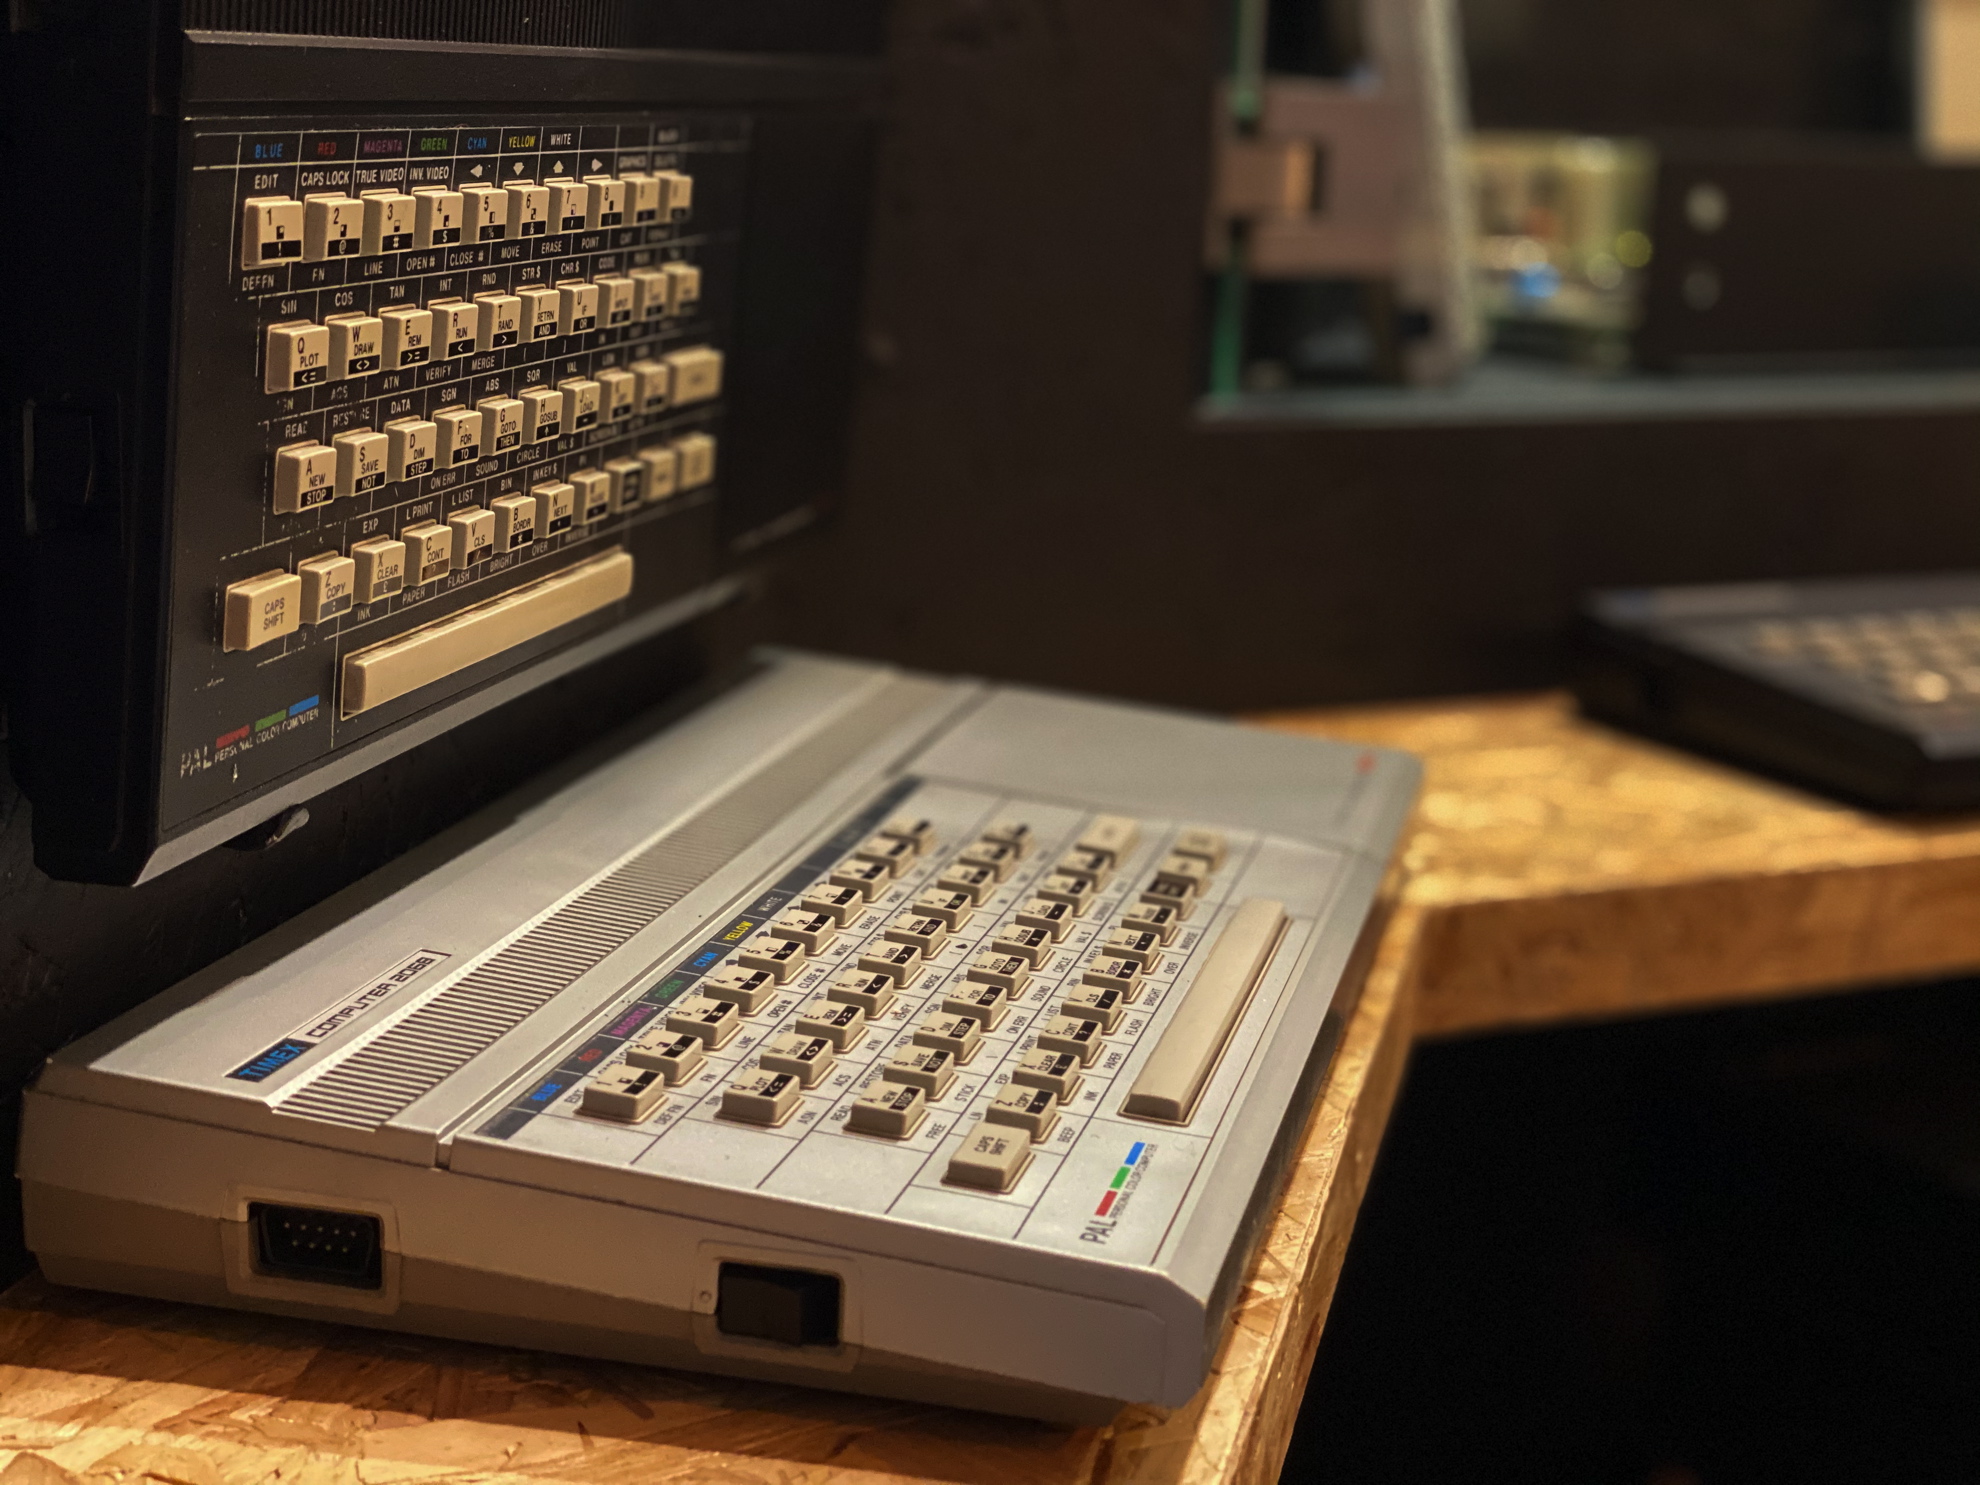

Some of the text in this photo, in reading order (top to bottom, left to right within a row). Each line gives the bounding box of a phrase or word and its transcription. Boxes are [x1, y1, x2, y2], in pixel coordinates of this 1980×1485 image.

[363, 138, 403, 154] MAGENTA
[420, 137, 448, 151] GREEN
[467, 136, 488, 151] CYAN
[508, 135, 537, 149] YELLOW
[550, 133, 572, 146] WHITE
[255, 142, 284, 159] BLUE
[318, 141, 337, 156] RED
[301, 169, 350, 187] CAPS LOCK
[356, 166, 405, 184] TRUE VIDEO
[409, 165, 450, 181] INV. VIDEO
[254, 173, 279, 190] EDIT
[436, 198, 443, 215] 4
[483, 195, 490, 212] 5
[525, 193, 532, 209] 6
[333, 207, 340, 225] 2
[387, 202, 394, 221] 3
[541, 240, 563, 255] ERASE
[581, 235, 600, 250] POINT
[450, 251, 473, 267] CLOSE
[501, 245, 520, 260] MOVE
[364, 260, 383, 277] LINE
[406, 257, 427, 272] OPEN
[312, 267, 325, 283] FN
[482, 272, 496, 286] RND
[389, 284, 405, 300] TAN
[439, 277, 452, 293] INT
[281, 299, 297, 315] SIN
[334, 291, 354, 307] COS
[537, 309, 555, 323] RETRN
[456, 325, 469, 340] RUN
[498, 318, 514, 332] RAND
[539, 324, 550, 337] AND
[579, 319, 588, 330] OR
[353, 341, 375, 357] DRAW
[408, 334, 422, 348] REM
[300, 353, 320, 369] PLOT
[471, 355, 496, 372] MERGE
[425, 365, 452, 383] VERIFY
[527, 368, 541, 383] SQR
[383, 375, 400, 391] ATN
[485, 377, 500, 392] ABS
[441, 388, 457, 403] SGN
[391, 397, 411, 415] DATA
[539, 410, 558, 425] GOSUB
[500, 419, 517, 435] GOTO
[460, 433, 473, 447] FOR
[500, 434, 515, 449] THEN
[413, 446, 425, 461] DIM
[461, 448, 469, 461] TO
[516, 446, 540, 464] CIRCLE
[361, 459, 379, 476] SAVE
[410, 460, 427, 477] STEP
[475, 459, 499, 477] SOUND
[308, 473, 326, 489] NEW
[361, 474, 377, 489] NOT
[430, 471, 457, 491] ON ERR
[500, 477, 513, 493] BIN
[306, 488, 327, 506] STOP
[452, 488, 474, 506] L LIST
[406, 500, 433, 521] L PRINT
[554, 504, 568, 518] NEXT
[363, 517, 379, 535] EXP
[513, 517, 531, 533] BORDR
[474, 534, 486, 549] CLS
[531, 541, 549, 557] OVER
[427, 547, 445, 564] CONT
[490, 552, 513, 573] BRIGHT
[377, 563, 399, 582] CLEAR
[447, 570, 470, 589] FLASH
[326, 582, 347, 601] COPY
[402, 586, 426, 606] PAPER
[264, 597, 285, 616] CAPS
[357, 606, 371, 623] INK
[263, 612, 285, 631] SHIFT
[758, 895, 783, 913] WHITE
[722, 920, 754, 941] YELLOW
[858, 915, 881, 930] ERASE
[1124, 934, 1139, 946] NEXT
[831, 943, 853, 957] MOVE
[882, 947, 900, 959] RAND
[693, 951, 719, 967] CYAN
[989, 958, 1006, 972] GOTO
[1053, 957, 1073, 973] CIRCLE
[1164, 961, 1180, 976] OVER
[798, 972, 822, 989] CLOSE
[854, 978, 870, 988] RUN
[920, 974, 943, 991] MERGE
[655, 979, 685, 999] GREEN
[968, 989, 984, 1000] FOR
[982, 993, 996, 1001] TO
[1031, 985, 1052, 1002] SOUND
[1086, 993, 1100, 1004] CLS
[1143, 988, 1163, 1007] BRIGHT
[238, 956, 437, 1078] TIMEX COMPUTER 2068
[610, 1006, 652, 1037] MAGENTA
[822, 1009, 839, 1020] REM
[953, 1022, 971, 1037] STEP
[1006, 1015, 1030, 1034] ON ERR
[1062, 1023, 1080, 1036] CONT
[1125, 1019, 1145, 1036] FLASH
[735, 1036, 757, 1049] LINE
[865, 1039, 884, 1051] ATN
[578, 1048, 603, 1062] RED
[910, 1053, 930, 1067] SAVE
[927, 1056, 943, 1069] NOT
[1037, 1055, 1058, 1071] CLEAR
[1103, 1052, 1124, 1070] PAPER
[700, 1073, 717, 1083] FN
[748, 1077, 771, 1091] PLOT
[832, 1074, 853, 1087] ACS
[995, 1073, 1010, 1085] EXP
[531, 1082, 562, 1102] BLUE
[895, 1092, 914, 1108] STOP
[954, 1083, 977, 1102] STICK
[1015, 1092, 1034, 1108] COPY
[1083, 1090, 1100, 1102] INK
[797, 1111, 819, 1125] ASN
[830, 1105, 853, 1121] READ
[969, 1112, 983, 1121] LN
[925, 1122, 947, 1140] FREE
[1057, 1126, 1076, 1144] BEEP
[974, 1136, 995, 1153] CAPS
[989, 1138, 1010, 1156] SHIFT
[1079, 1220, 1118, 1245] PAL
